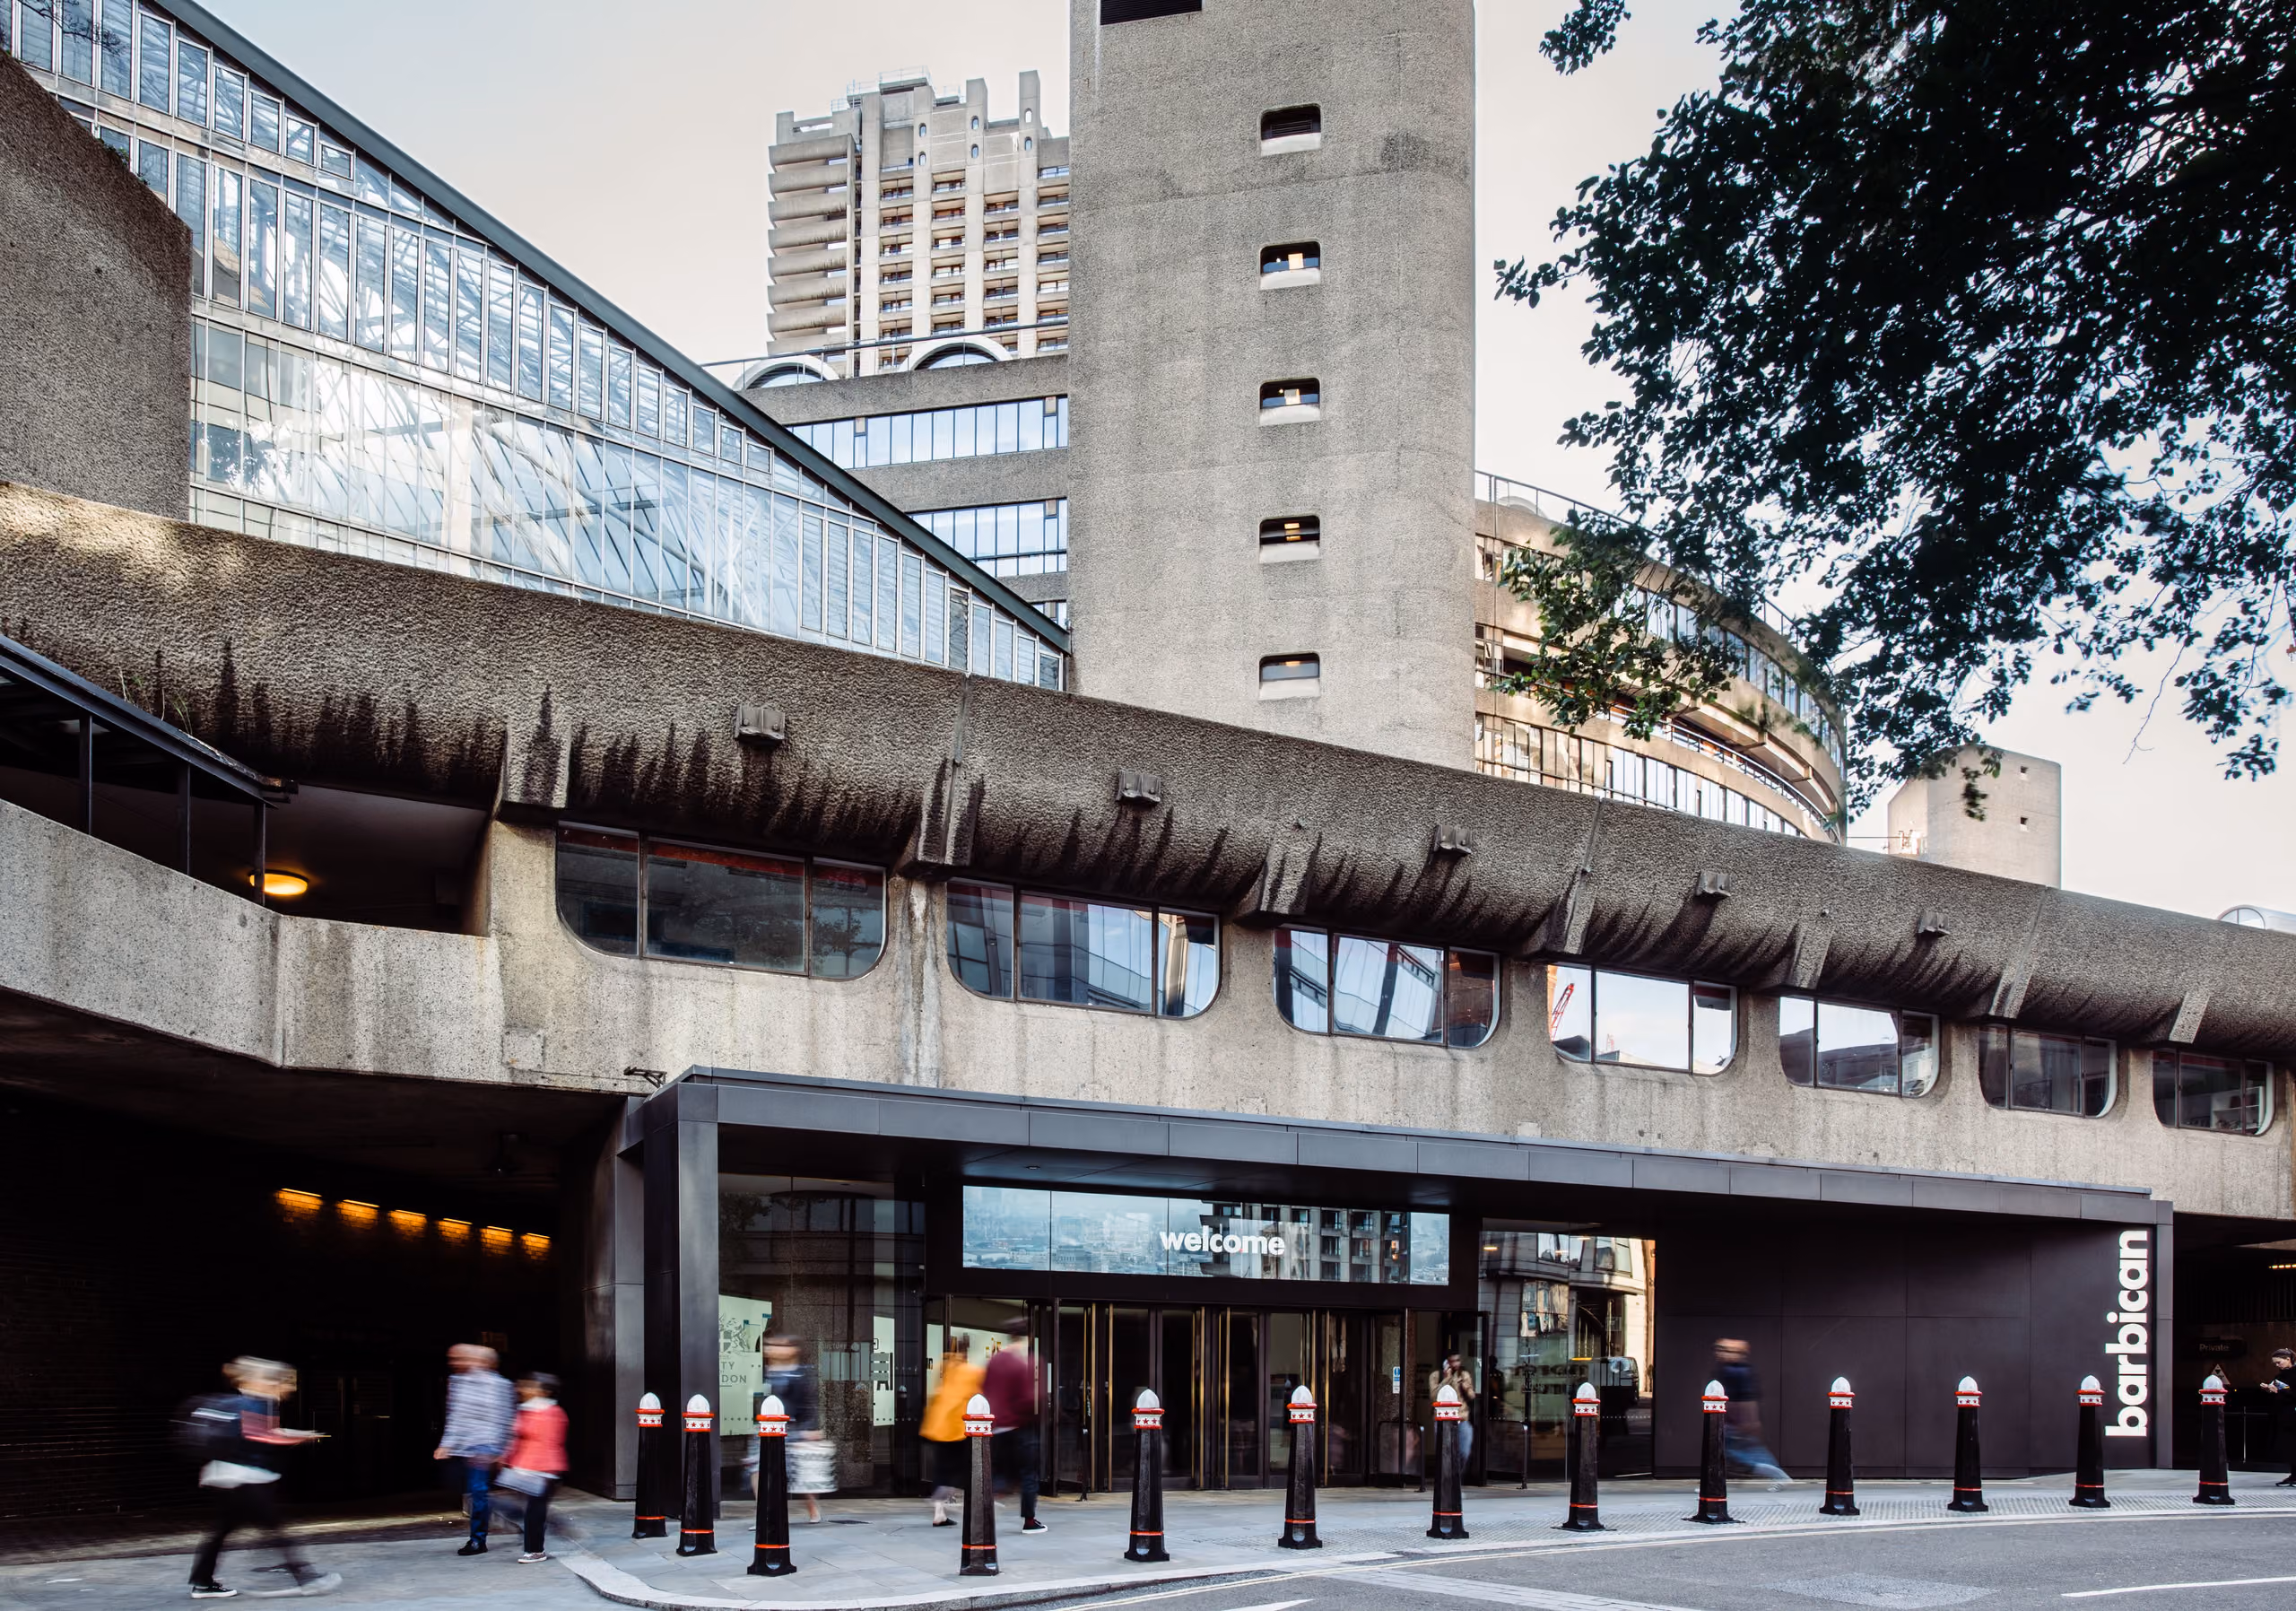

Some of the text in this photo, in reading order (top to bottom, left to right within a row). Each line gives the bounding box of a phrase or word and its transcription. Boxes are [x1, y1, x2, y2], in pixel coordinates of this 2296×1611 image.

[1159, 1224, 1285, 1256] welcome
[2105, 1230, 2149, 1437] barbican
[2199, 1343, 2231, 1352] Private
